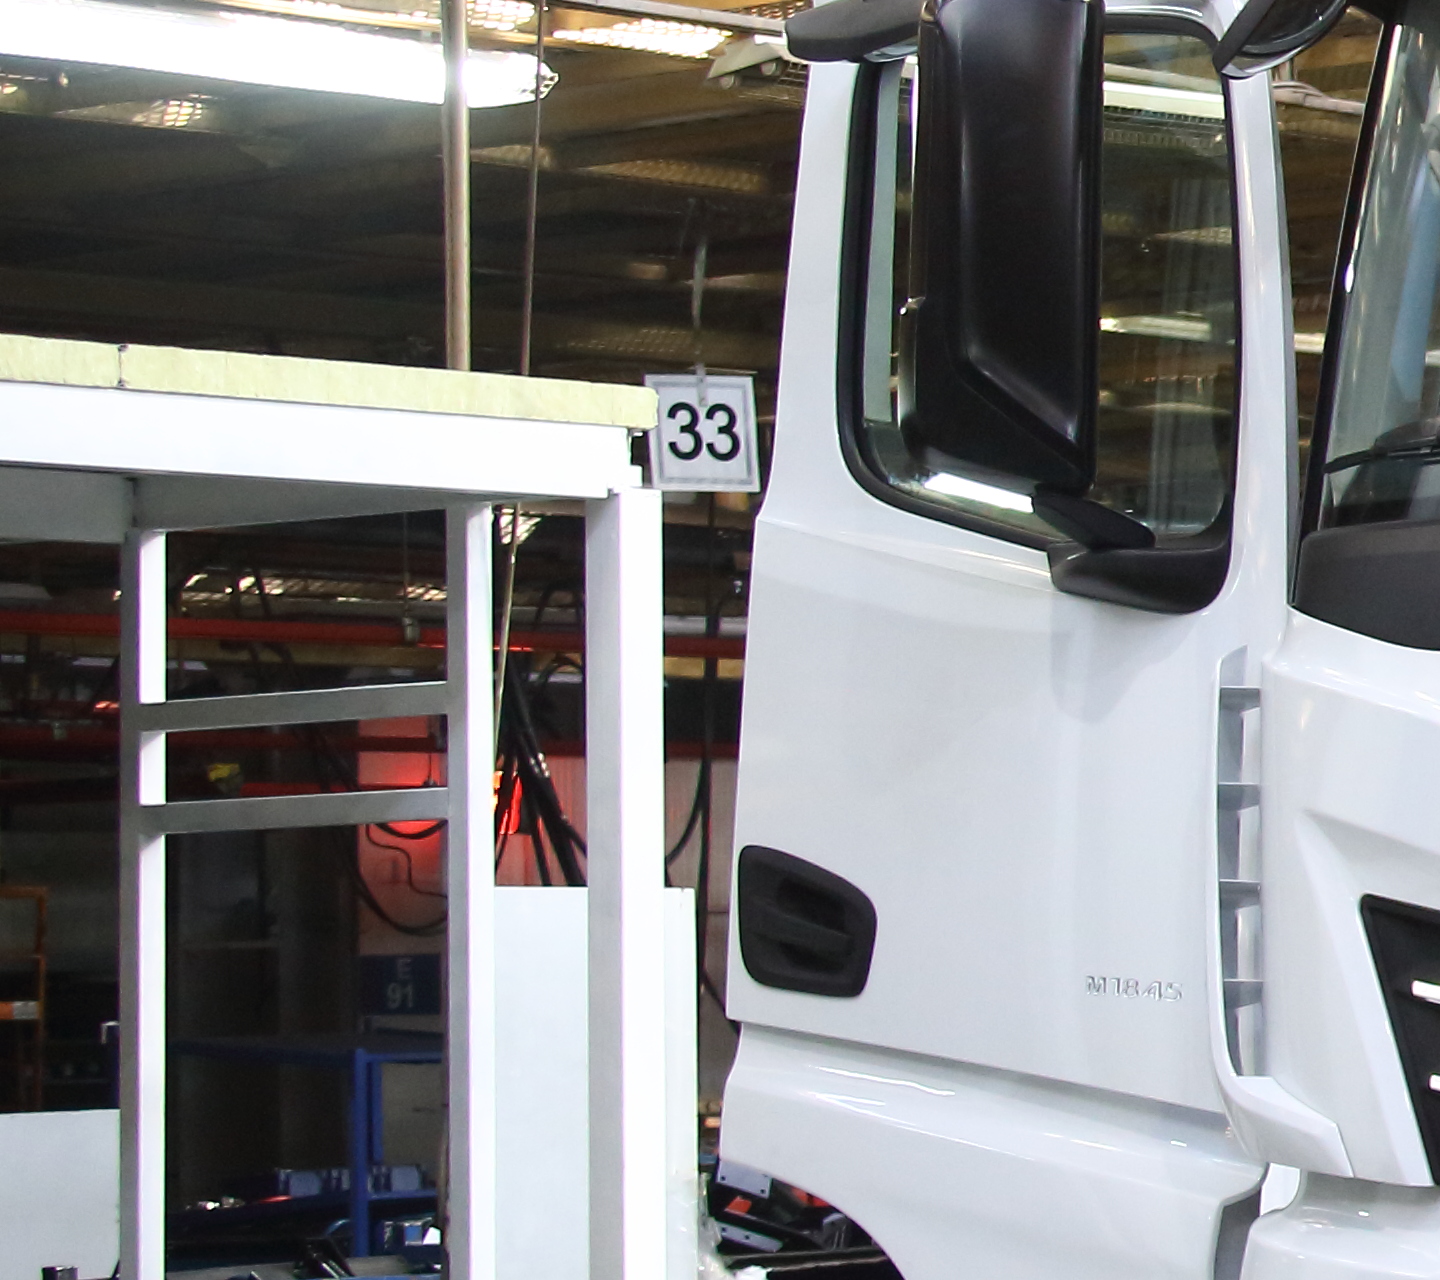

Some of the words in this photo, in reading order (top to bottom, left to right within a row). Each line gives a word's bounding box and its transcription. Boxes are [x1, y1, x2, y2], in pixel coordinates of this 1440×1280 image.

[667, 402, 741, 461] 33
[386, 982, 414, 1010] 91
[1085, 975, 1183, 1001] M1845
